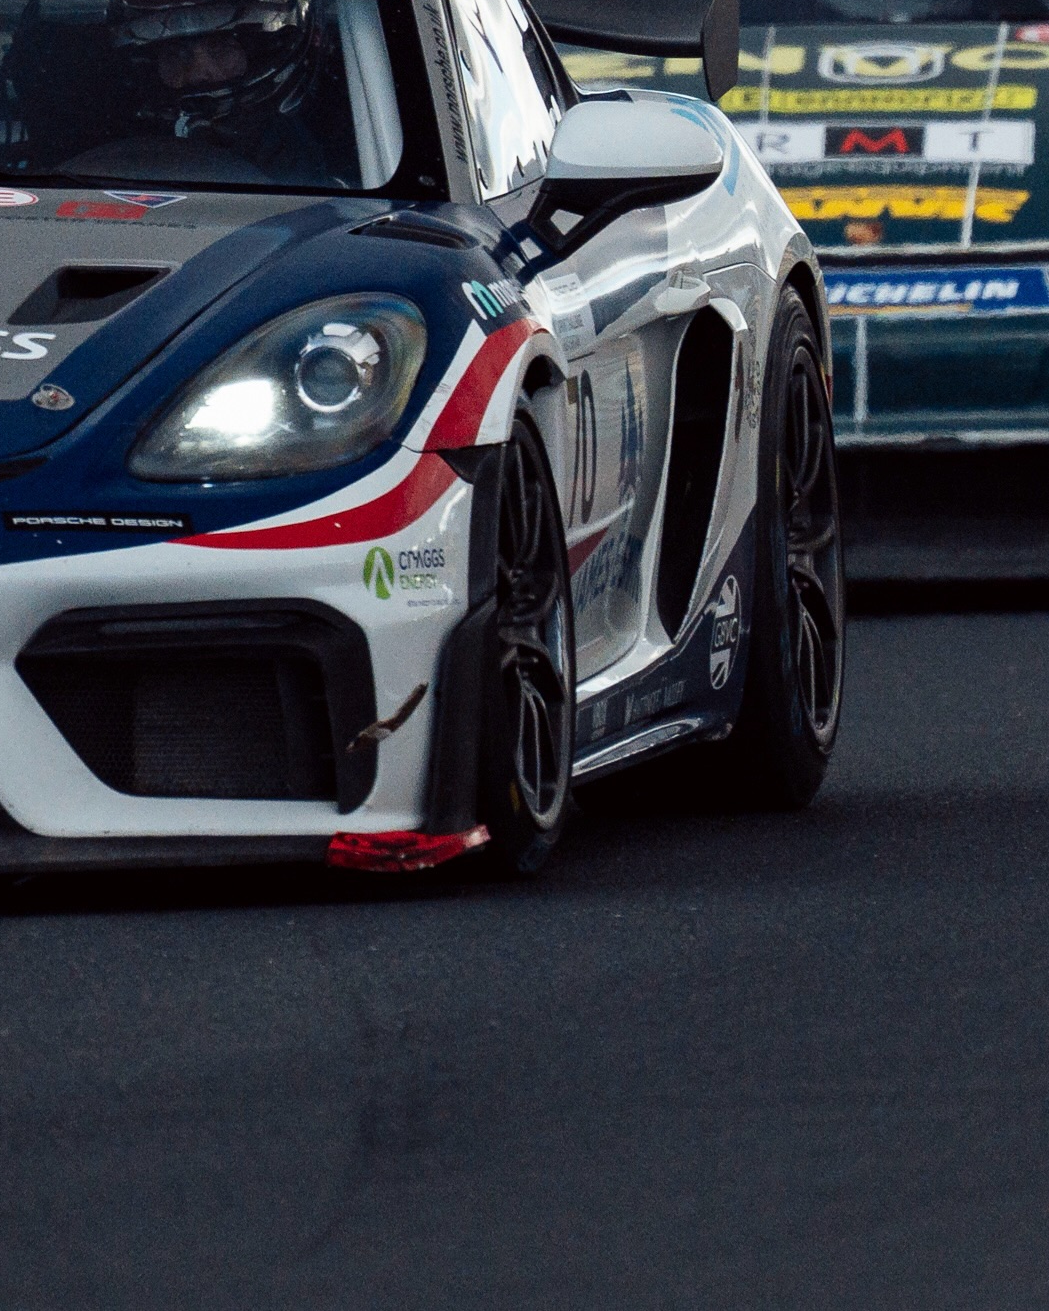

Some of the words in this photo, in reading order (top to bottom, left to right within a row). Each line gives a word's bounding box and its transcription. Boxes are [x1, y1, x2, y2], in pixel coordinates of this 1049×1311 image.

[825, 279, 1020, 304] ICHELIN
[12, 517, 107, 526] PORSCHE
[110, 518, 184, 528] DESIGN
